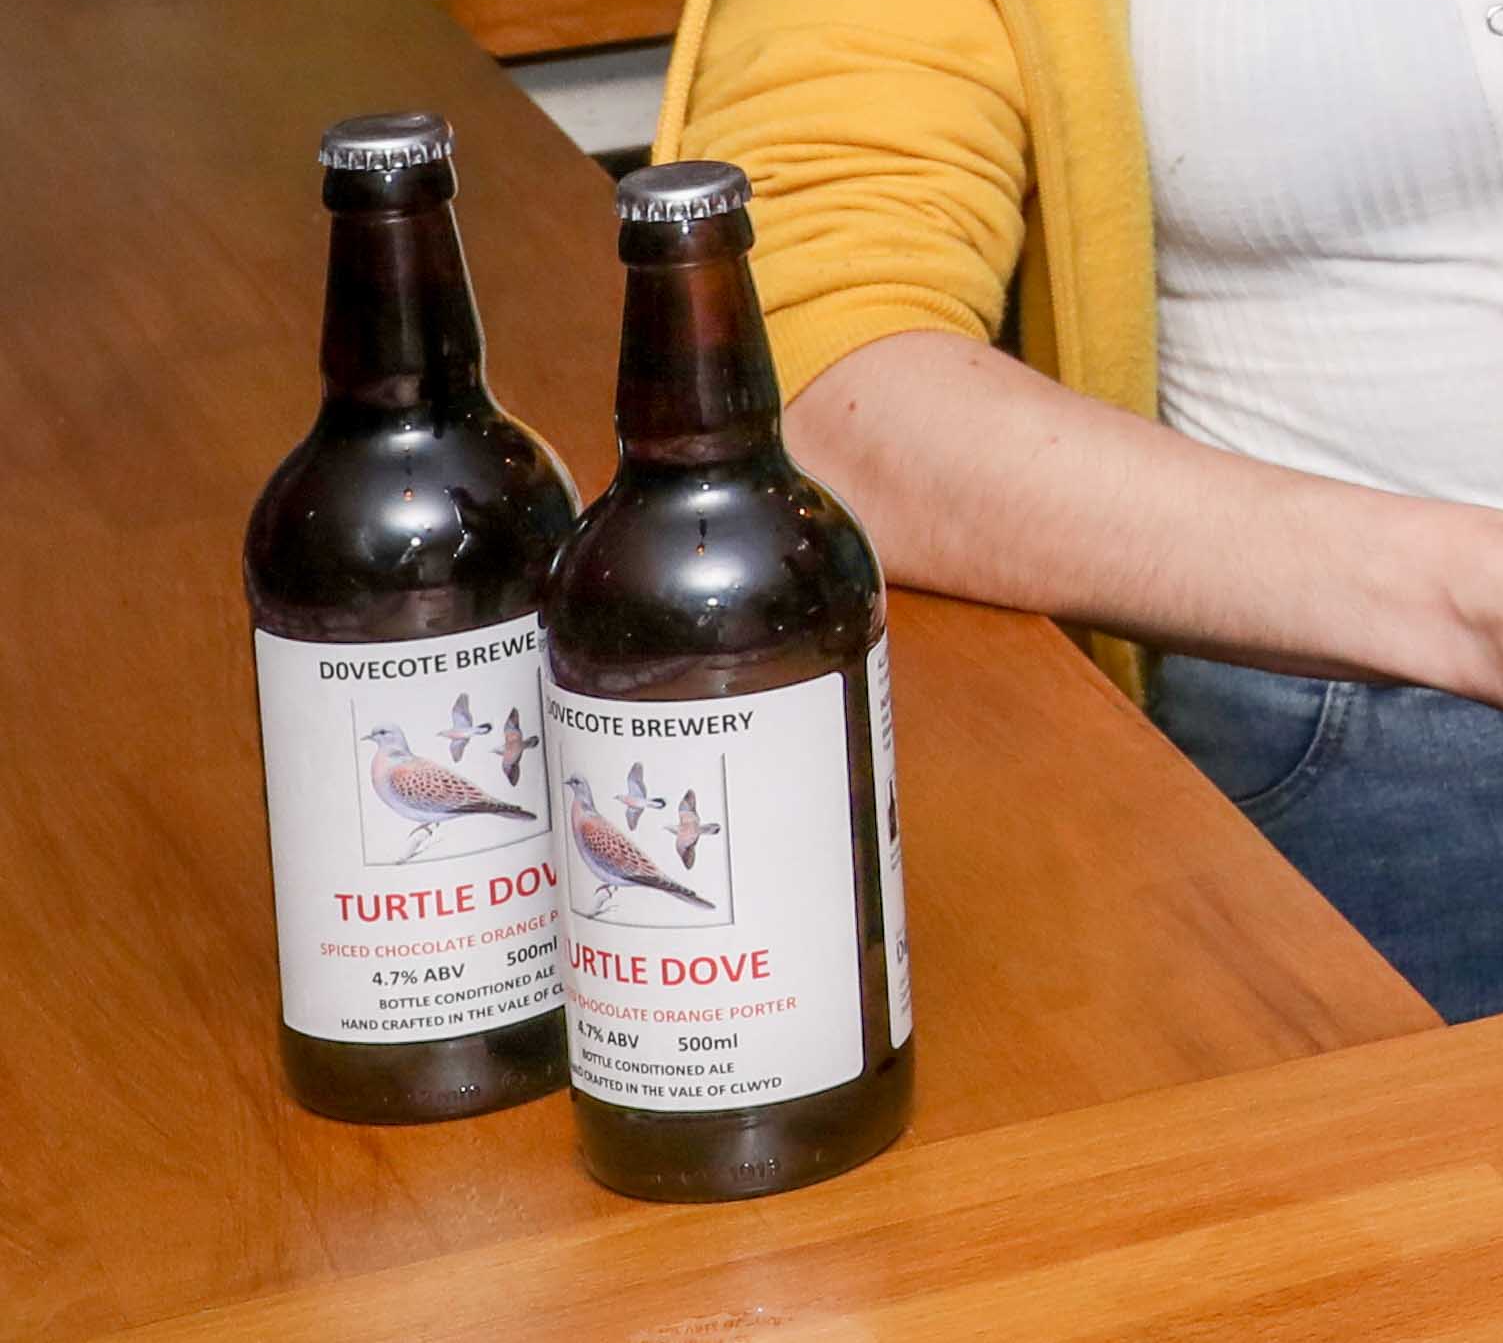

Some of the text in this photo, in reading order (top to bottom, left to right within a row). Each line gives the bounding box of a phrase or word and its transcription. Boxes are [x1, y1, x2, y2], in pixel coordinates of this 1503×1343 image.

[319, 653, 449, 681] DOVECOTE
[630, 709, 755, 740] BREWERY
[333, 861, 559, 924] TURTLE DOV
[320, 917, 547, 959] SPICED CHOCOLATE ORANGE
[371, 935, 559, 988] 4.7% ABV 500ml
[660, 948, 772, 987] DOVE
[378, 994, 431, 1011] BOTTLE
[433, 975, 533, 1007] CONDITIONED
[534, 965, 556, 982] ALE
[340, 1018, 379, 1032] HAND
[381, 1015, 445, 1032] CRAFTED
[449, 1011, 464, 1025] IN
[466, 1004, 495, 1022] THE
[497, 994, 532, 1015] VALE
[533, 986, 550, 1003] OF
[652, 995, 799, 1024] ORANGE PORTER
[606, 1029, 739, 1053] ABV 500ml
[614, 1059, 736, 1077] CONDITIONED ALE
[642, 1075, 783, 1099] THE VALE OF CLWYD
